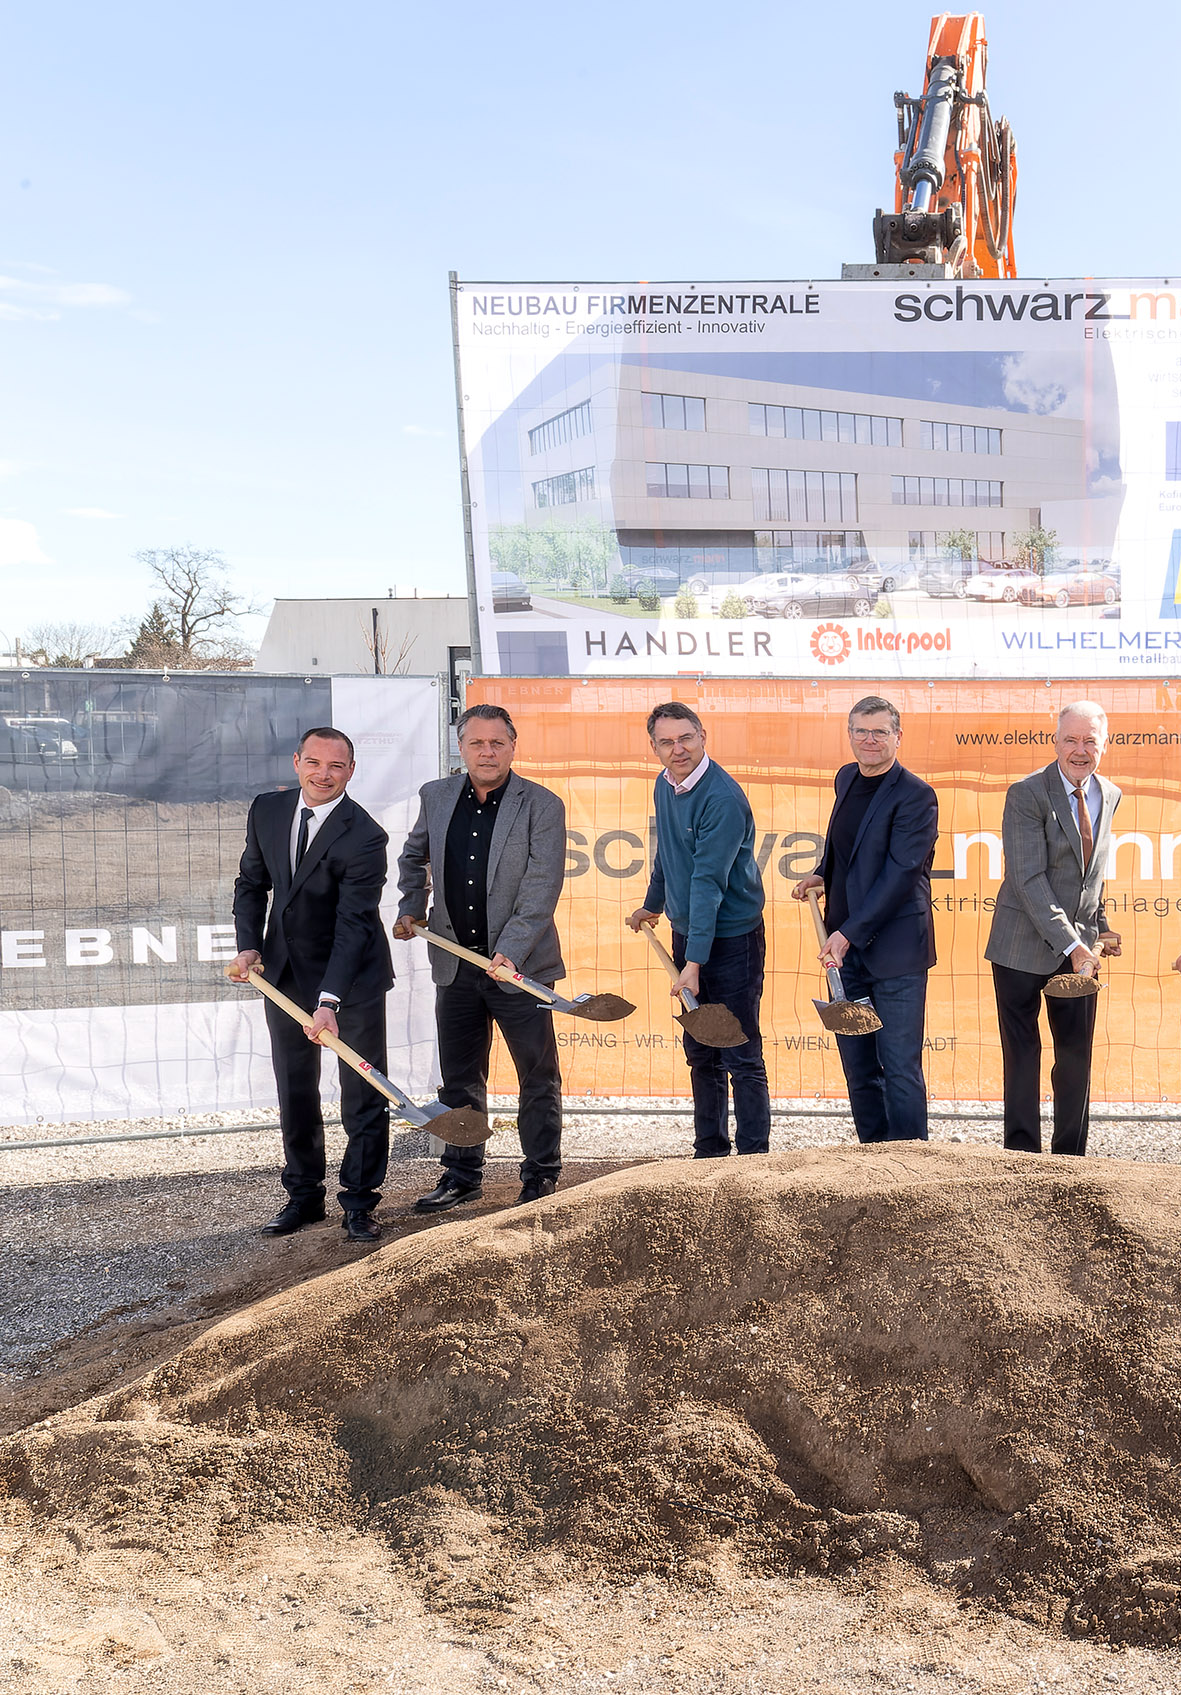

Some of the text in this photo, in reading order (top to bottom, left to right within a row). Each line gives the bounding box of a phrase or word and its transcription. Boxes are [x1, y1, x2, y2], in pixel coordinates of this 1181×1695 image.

[472, 294, 820, 316] NEUBAU FIRMENZENTRALE
[472, 321, 550, 338] Nachhaltig
[565, 319, 682, 338] Energieeffizient
[697, 320, 766, 334] Innovativ
[585, 630, 773, 657] HANDLER
[857, 627, 951, 654] Inter-pool
[1, 925, 238, 968] EBNE
[557, 1032, 617, 1048] SPANG
[635, 1034, 668, 1048] WR.
[785, 1036, 830, 1051] WIEN
